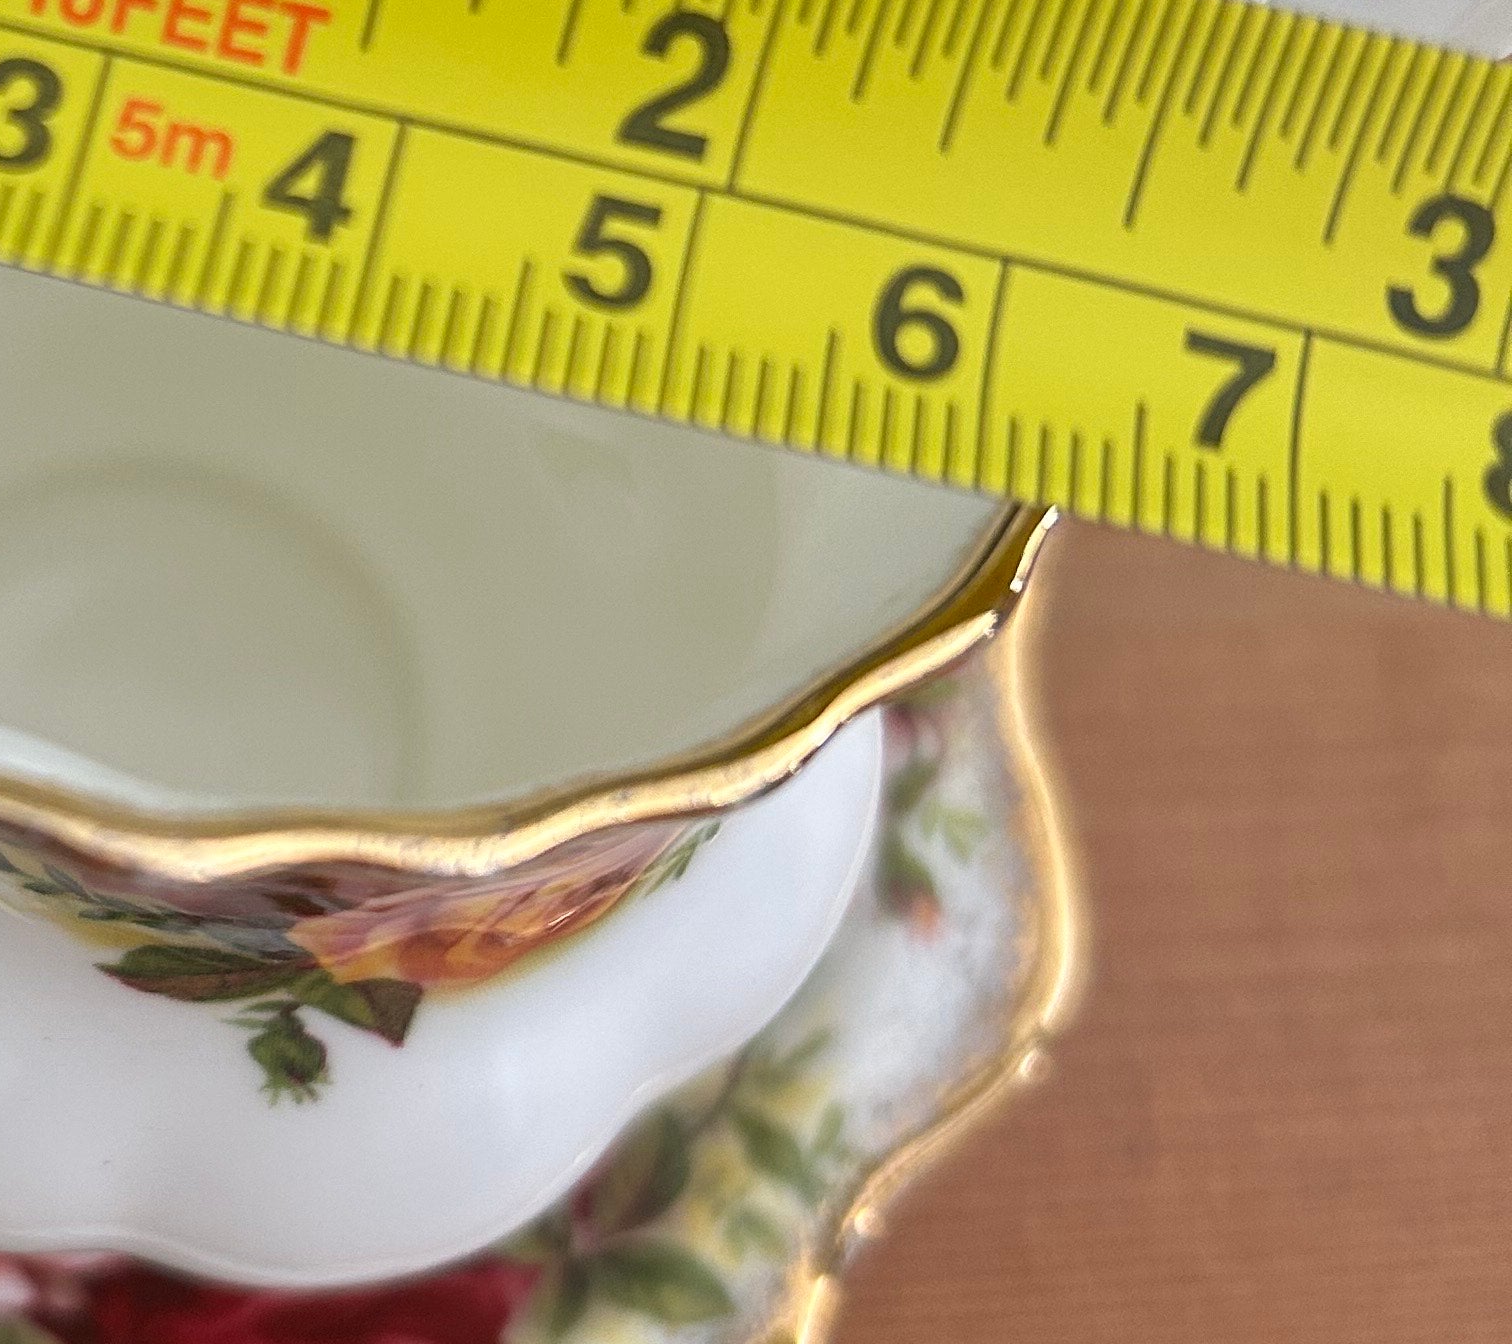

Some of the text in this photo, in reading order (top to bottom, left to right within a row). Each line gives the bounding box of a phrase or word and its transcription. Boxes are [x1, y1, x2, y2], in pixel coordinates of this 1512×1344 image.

[108, 97, 236, 182] 5m
[616, 8, 734, 164] 2
[258, 128, 359, 247] 4
[559, 192, 665, 315] 5
[1384, 193, 1497, 341] 3
[871, 265, 966, 383] 6
[1181, 329, 1278, 451] 7
